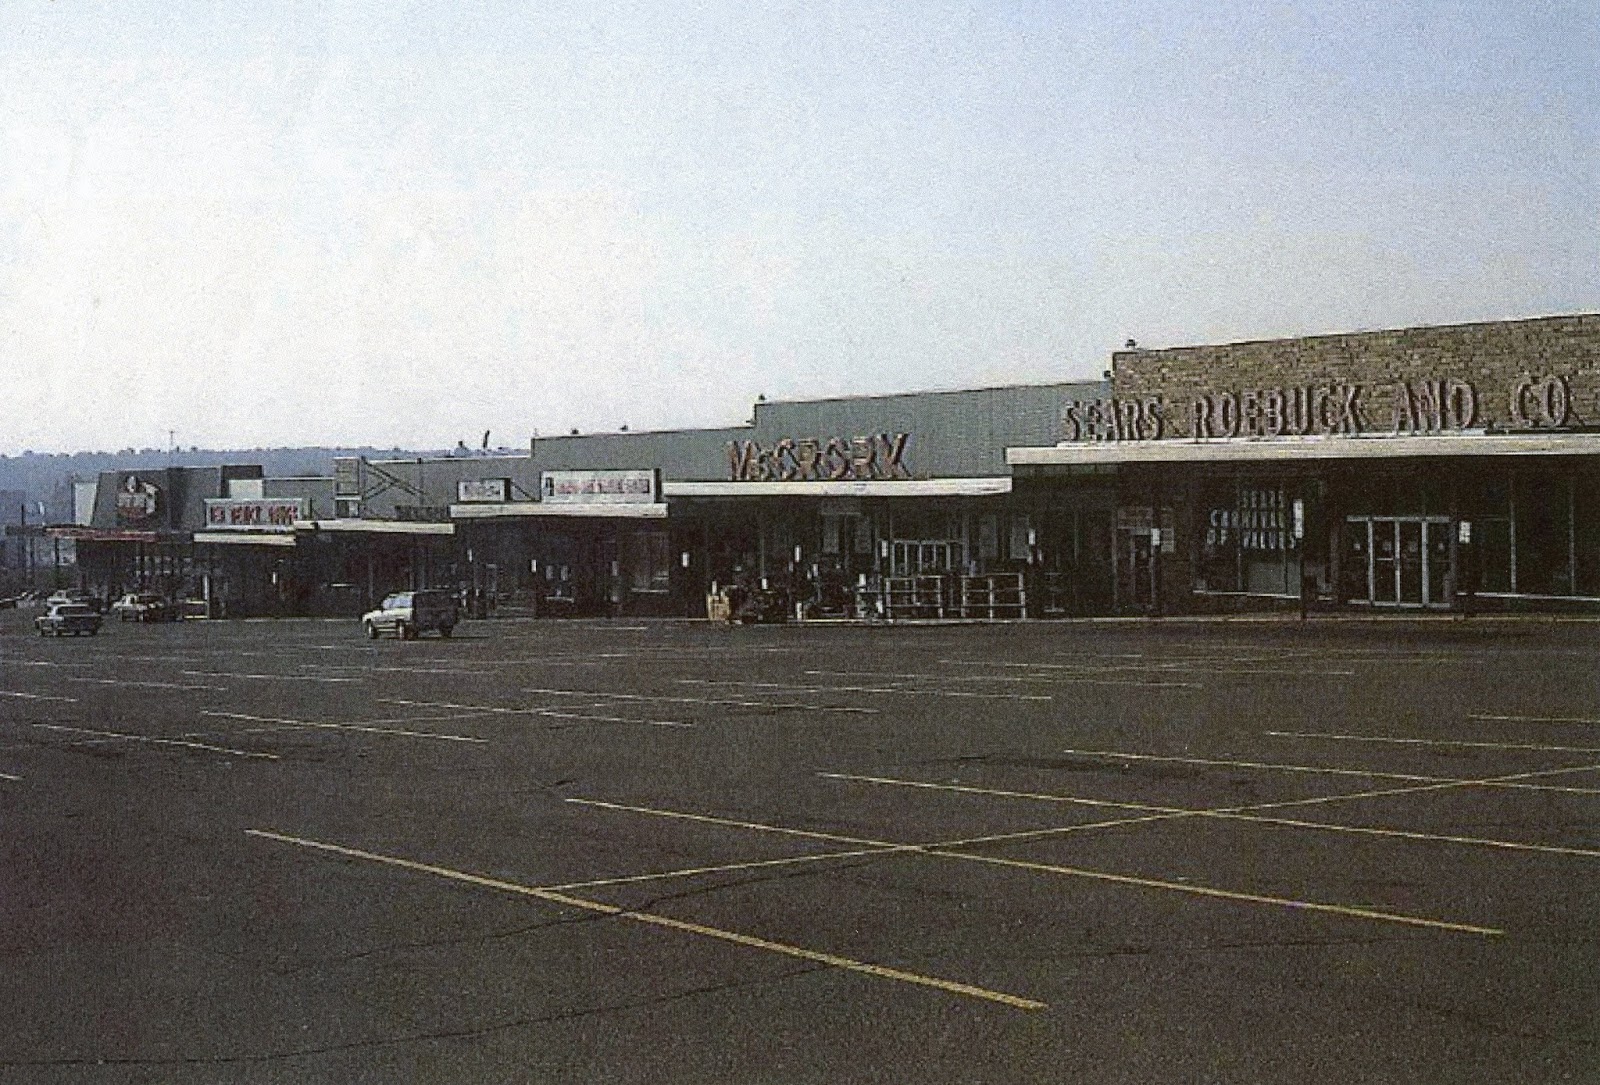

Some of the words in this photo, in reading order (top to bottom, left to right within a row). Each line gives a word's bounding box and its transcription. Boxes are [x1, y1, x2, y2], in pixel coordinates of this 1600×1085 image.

[1063, 396, 1165, 442] SEARS
[1193, 385, 1365, 442] ROEBUCK
[1391, 377, 1478, 435] AND
